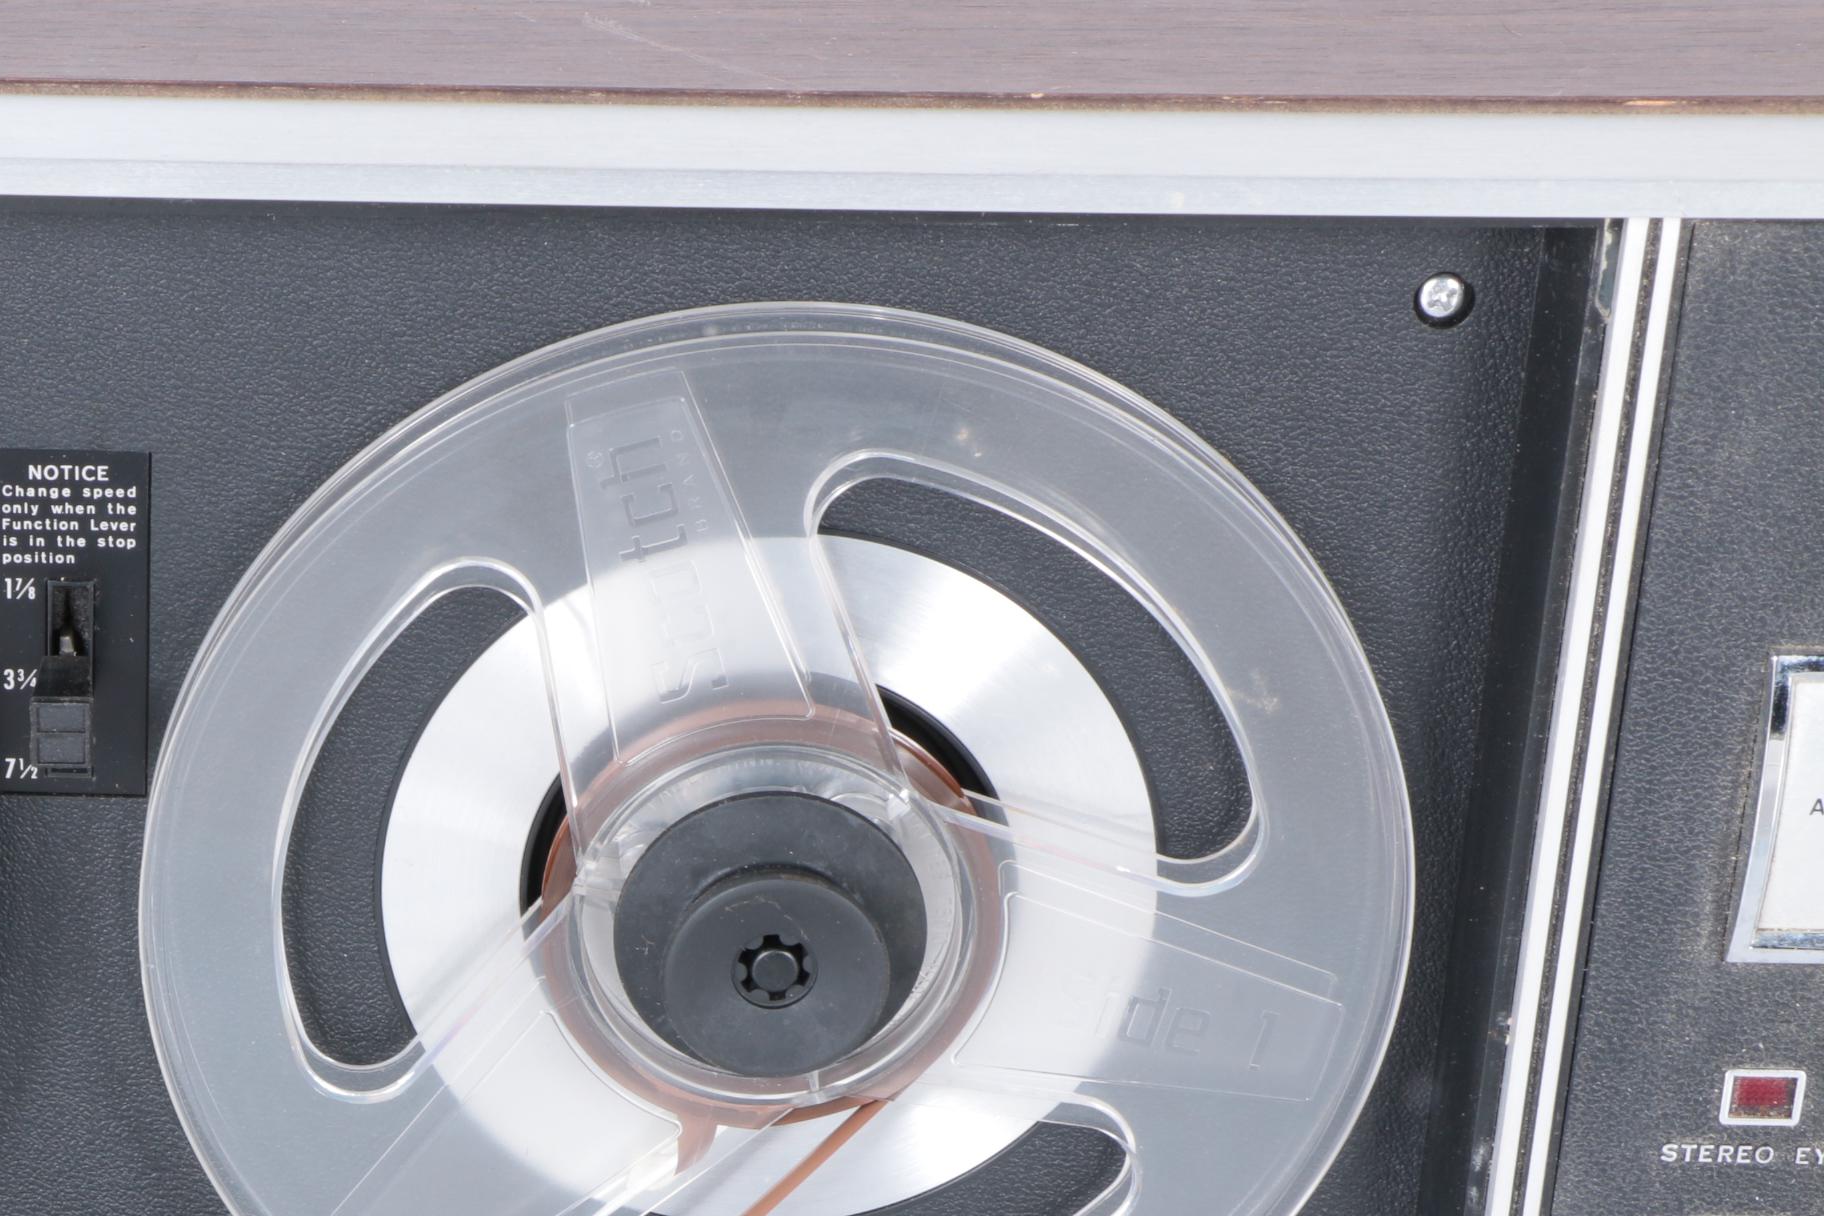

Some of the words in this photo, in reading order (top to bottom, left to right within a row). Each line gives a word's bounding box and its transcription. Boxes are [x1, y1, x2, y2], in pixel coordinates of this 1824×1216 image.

[28, 465, 110, 481] NOTICE
[1, 485, 72, 499] Change
[82, 486, 137, 500] speed
[1, 502, 39, 516] only
[51, 502, 96, 514] when
[107, 502, 137, 515] the
[1, 518, 79, 531] Function
[90, 519, 137, 532] Lever
[3, 534, 18, 547] is
[29, 534, 45, 547] in
[57, 535, 87, 548] the
[97, 536, 137, 550] stop
[2, 552, 75, 565] position
[1660, 1143, 1775, 1164] STEREO
